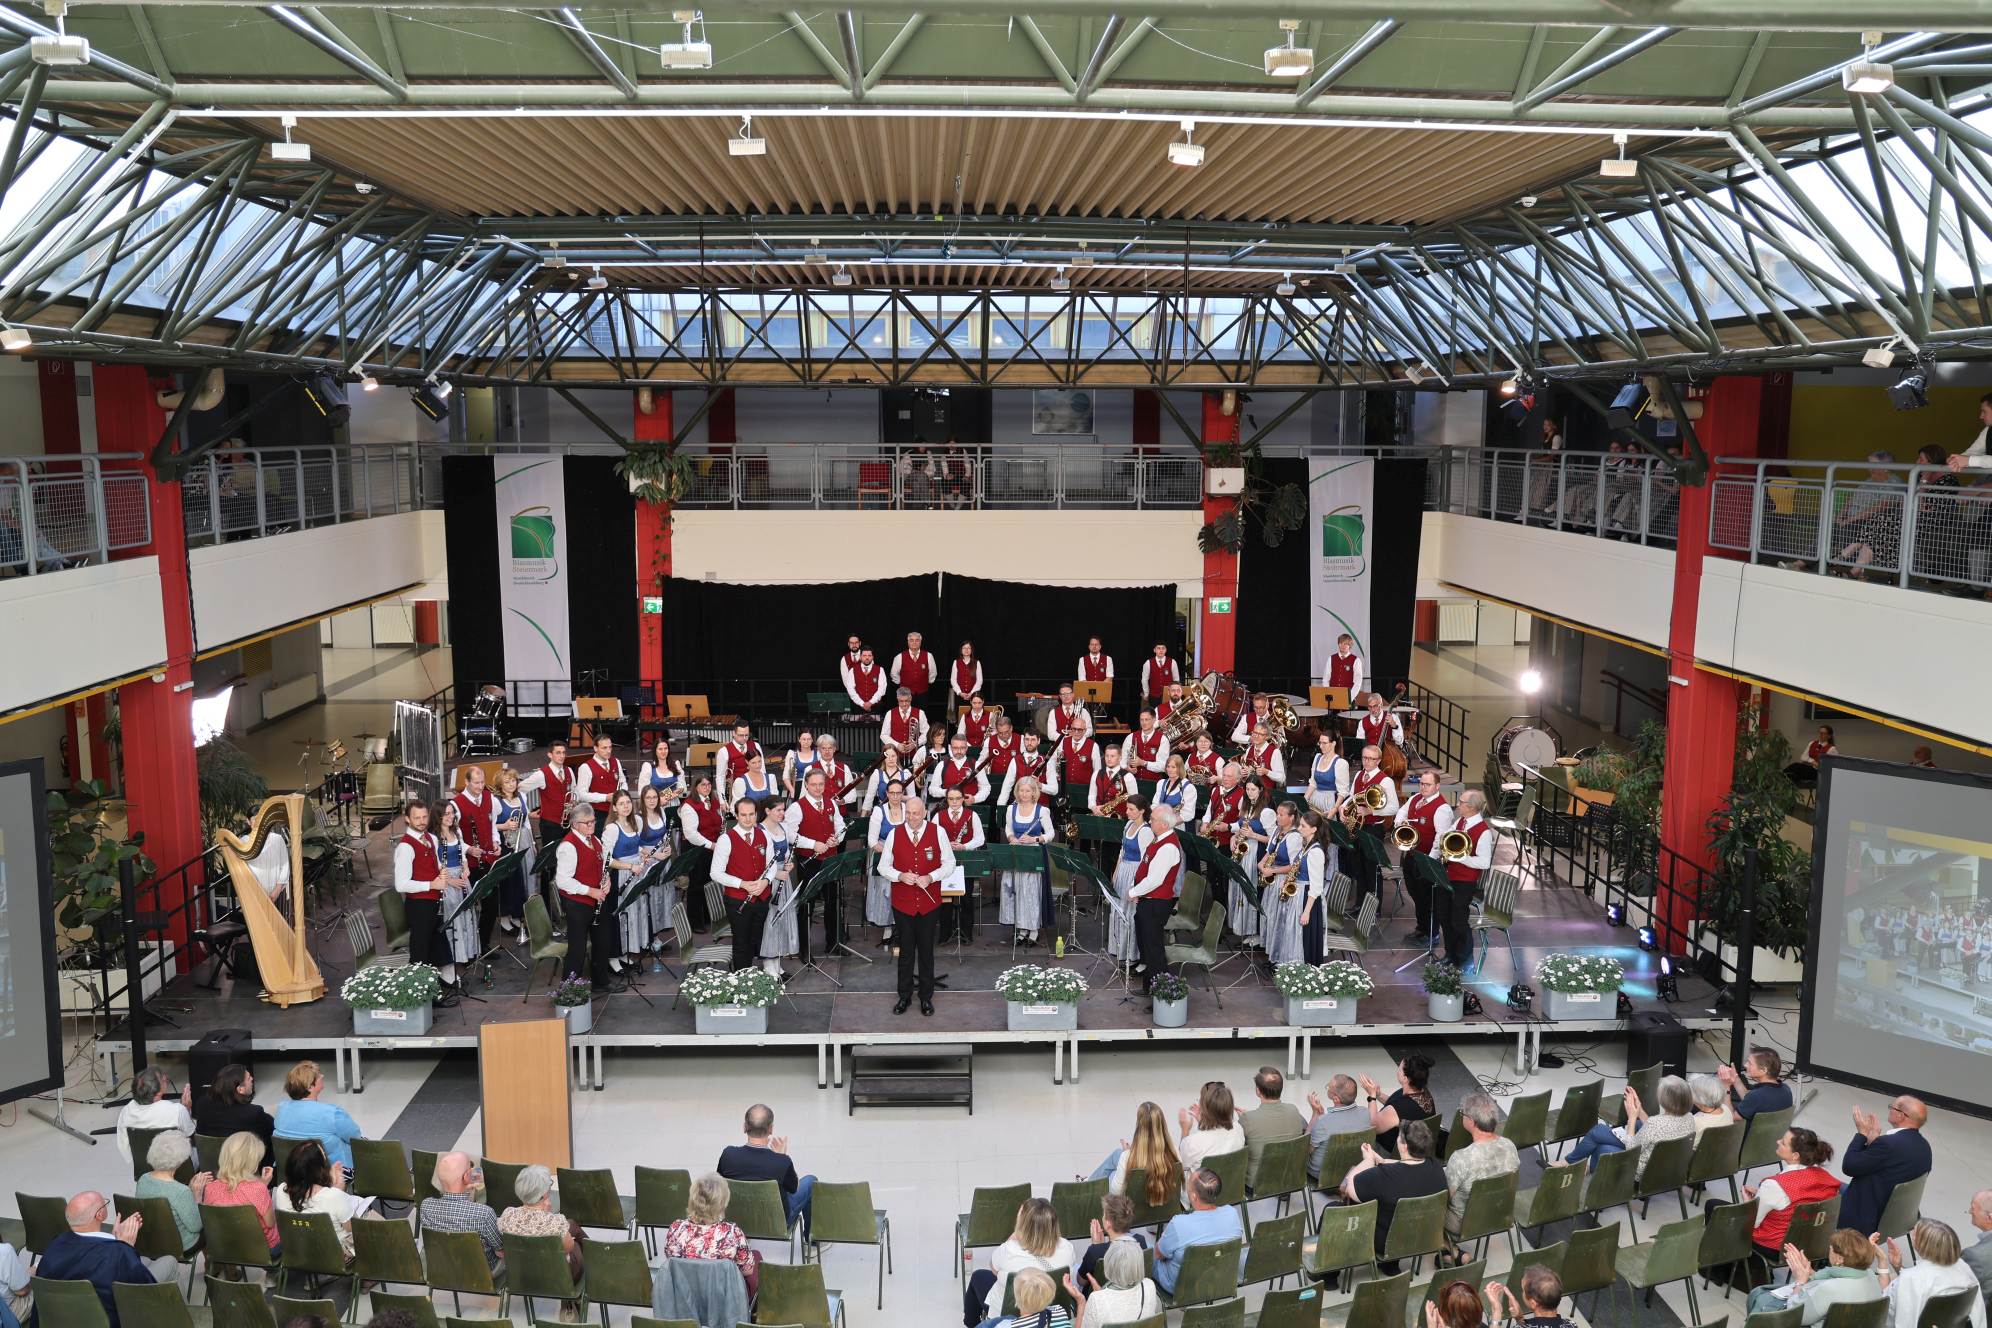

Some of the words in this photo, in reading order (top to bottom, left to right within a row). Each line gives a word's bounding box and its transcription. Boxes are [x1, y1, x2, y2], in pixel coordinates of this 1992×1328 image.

[1560, 1173, 1573, 1188] B
[1346, 1216, 1360, 1231] B
[1813, 1211, 1826, 1226] B
